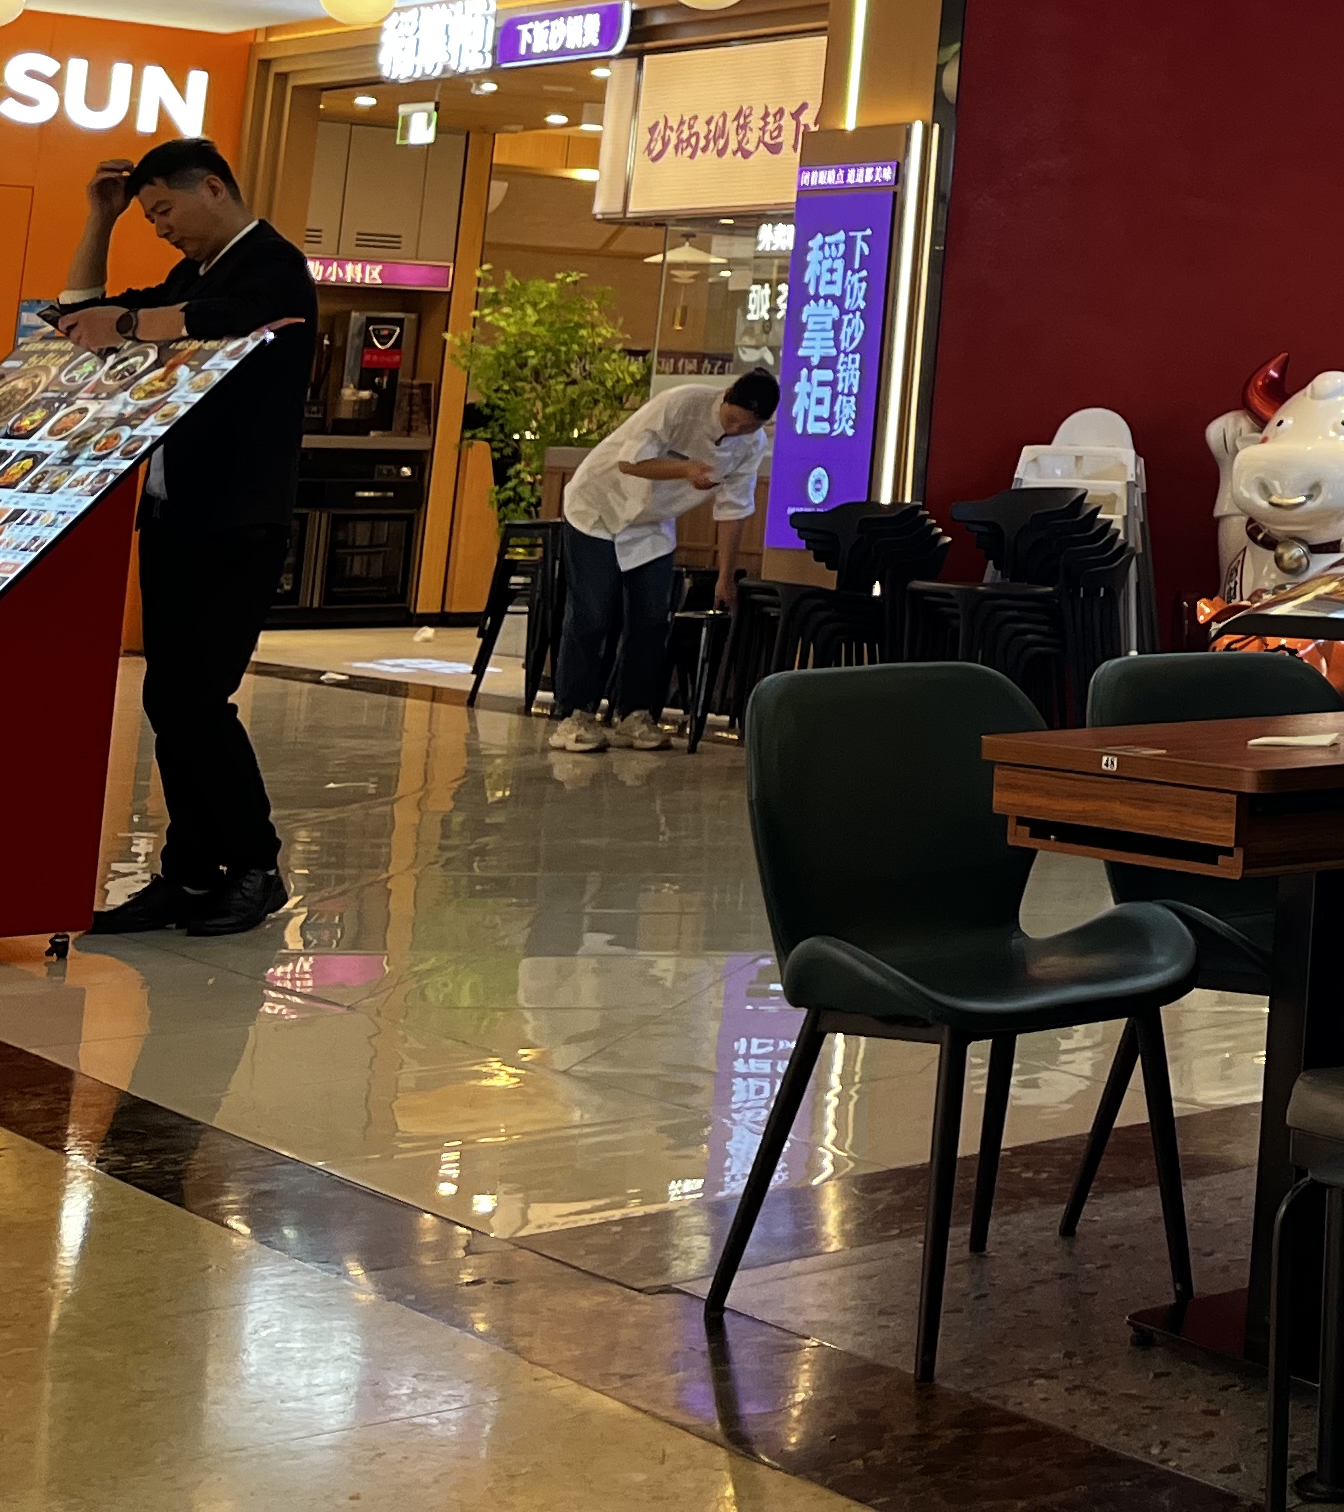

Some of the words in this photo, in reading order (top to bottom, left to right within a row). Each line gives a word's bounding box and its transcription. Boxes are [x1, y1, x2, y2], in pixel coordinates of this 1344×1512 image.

[1, 52, 209, 137] SUN
[643, 101, 819, 164] 砂锅现煲超下
[792, 229, 846, 435] 稻掌柜
[830, 227, 873, 437] 下饭砂锅煲
